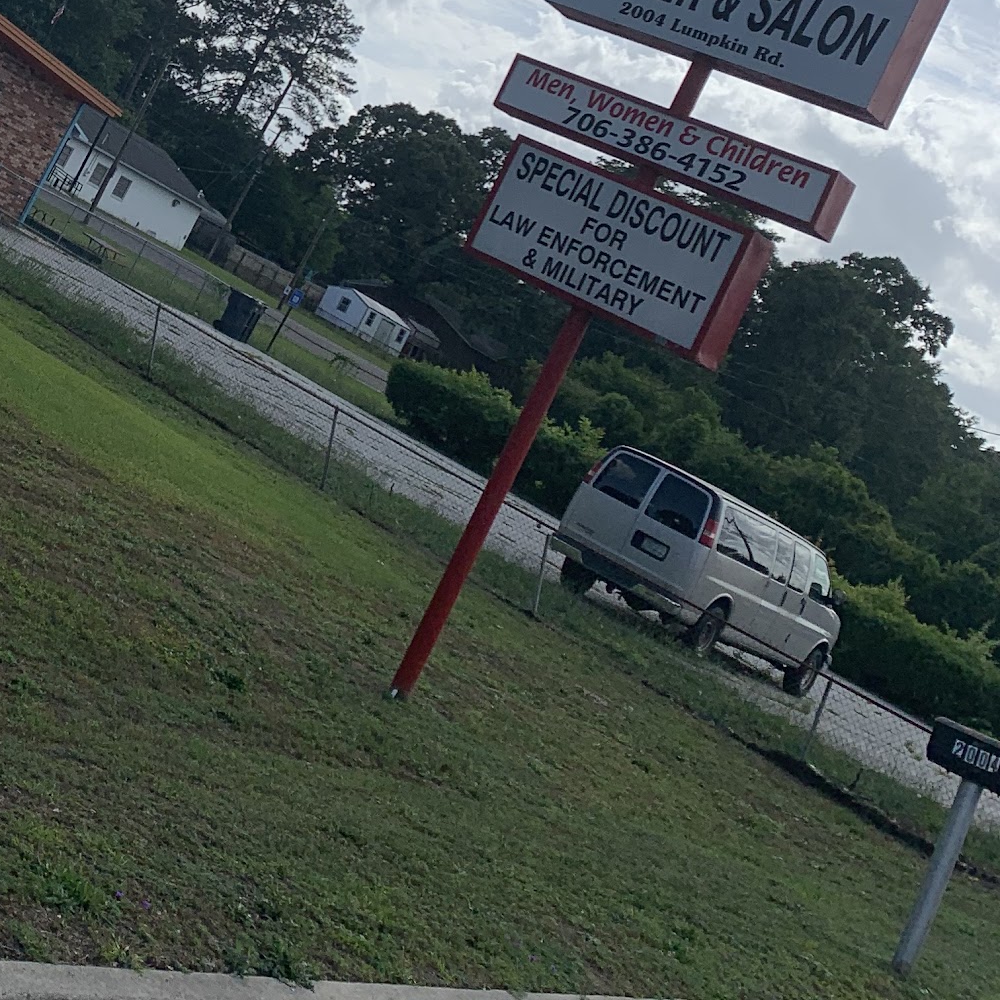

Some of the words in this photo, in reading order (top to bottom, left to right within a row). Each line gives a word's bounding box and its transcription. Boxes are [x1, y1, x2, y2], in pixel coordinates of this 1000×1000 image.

[619, 1, 667, 27] 2004
[670, 19, 749, 54] Lumpkin
[753, 45, 785, 68] Rd.
[526, 69, 578, 104] Men,
[587, 89, 674, 137] Women
[679, 125, 701, 147] &
[706, 135, 811, 189] Children
[562, 107, 747, 192] 706-386-4152
[517, 152, 602, 213] SPECIAL
[607, 190, 732, 263] DISCOUNT
[581, 217, 628, 251] FOR
[489, 205, 537, 238] LAW
[537, 229, 707, 314] ENFORCEMENT
[522, 248, 539, 268] &
[542, 256, 646, 317] MILITARY
